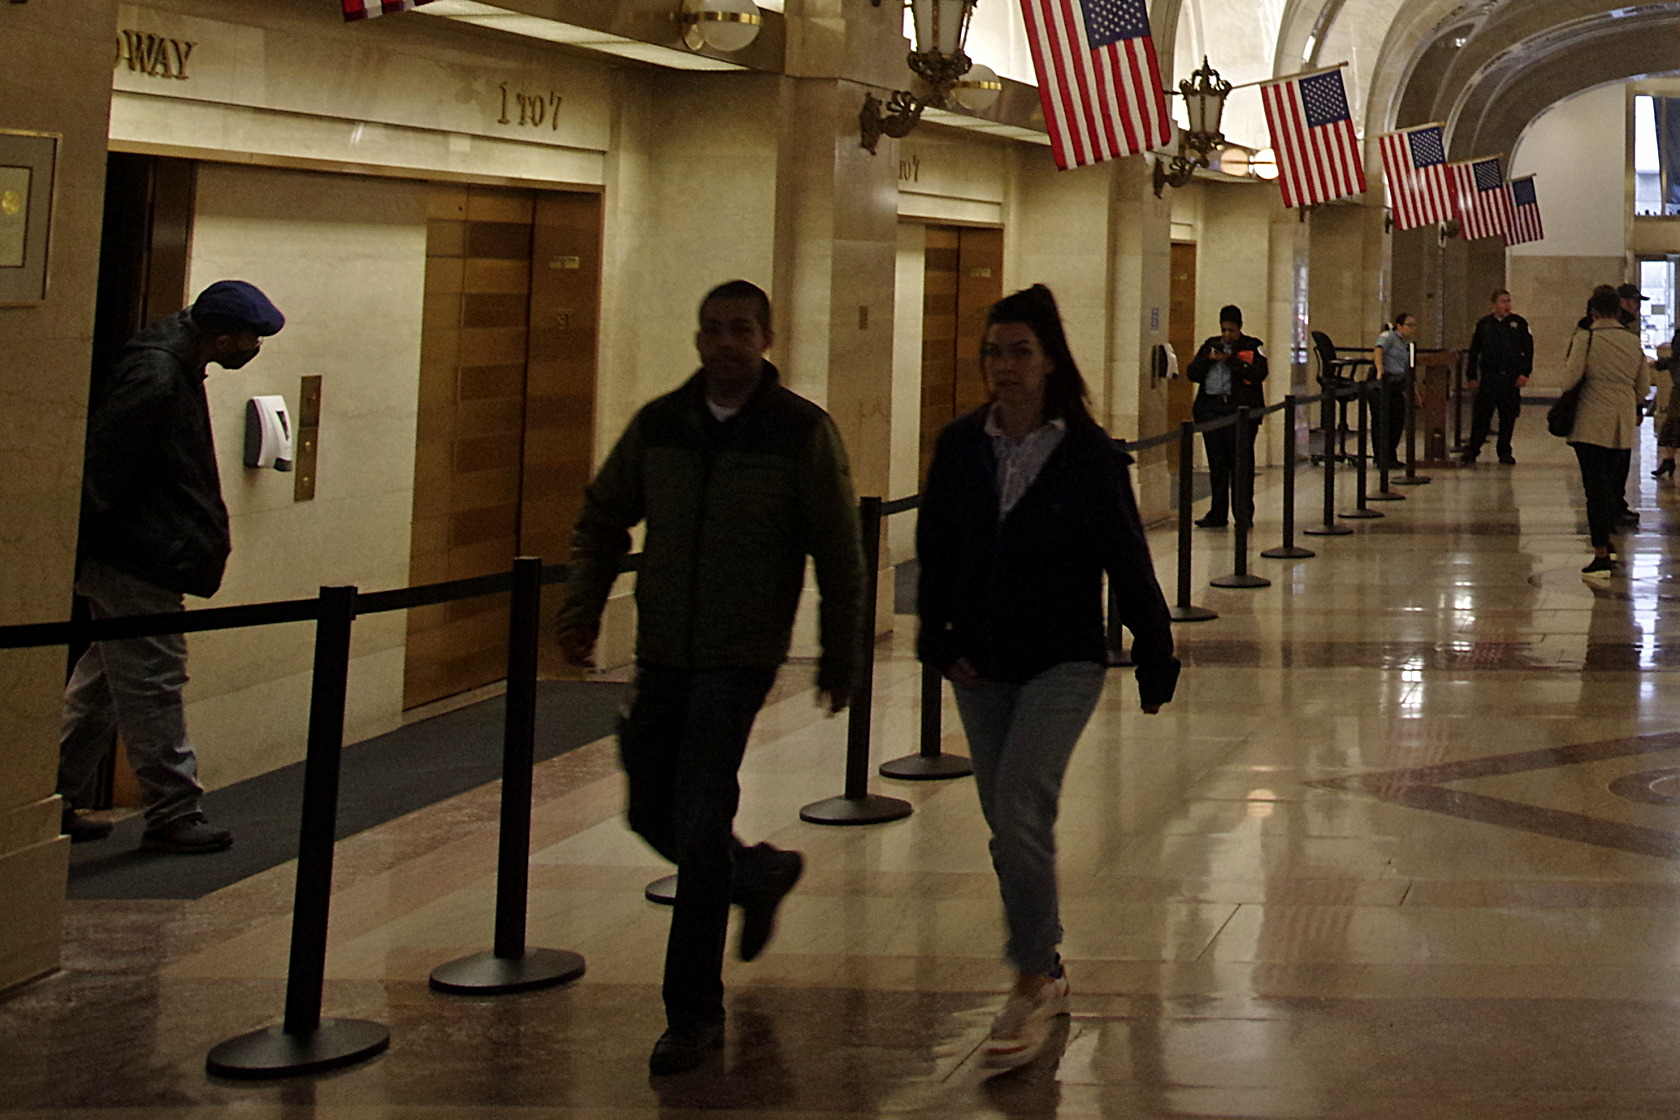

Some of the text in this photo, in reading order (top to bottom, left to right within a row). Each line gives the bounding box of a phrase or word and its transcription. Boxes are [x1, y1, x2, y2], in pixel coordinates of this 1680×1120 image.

[115, 29, 198, 81] WAY
[498, 81, 562, 131] 1 TO 7
